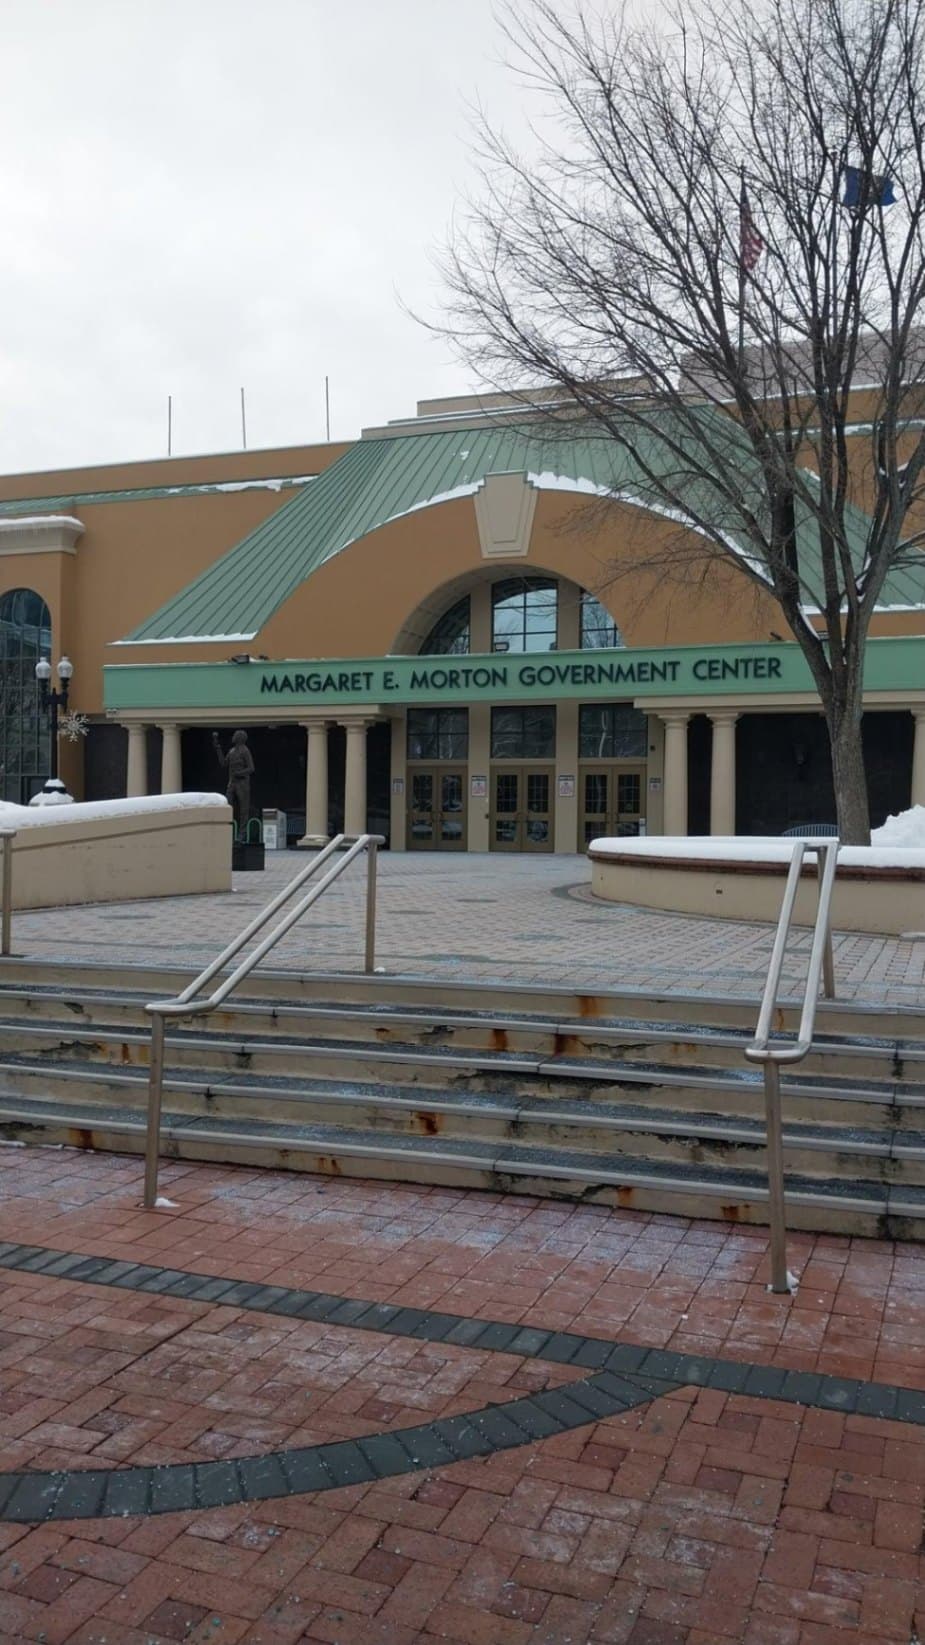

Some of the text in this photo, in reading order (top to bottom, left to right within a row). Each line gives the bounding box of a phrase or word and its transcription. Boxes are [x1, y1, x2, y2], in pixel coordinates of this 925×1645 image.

[261, 657, 782, 693] MARGARET E. MORTON GOVERNMENT CENTER
